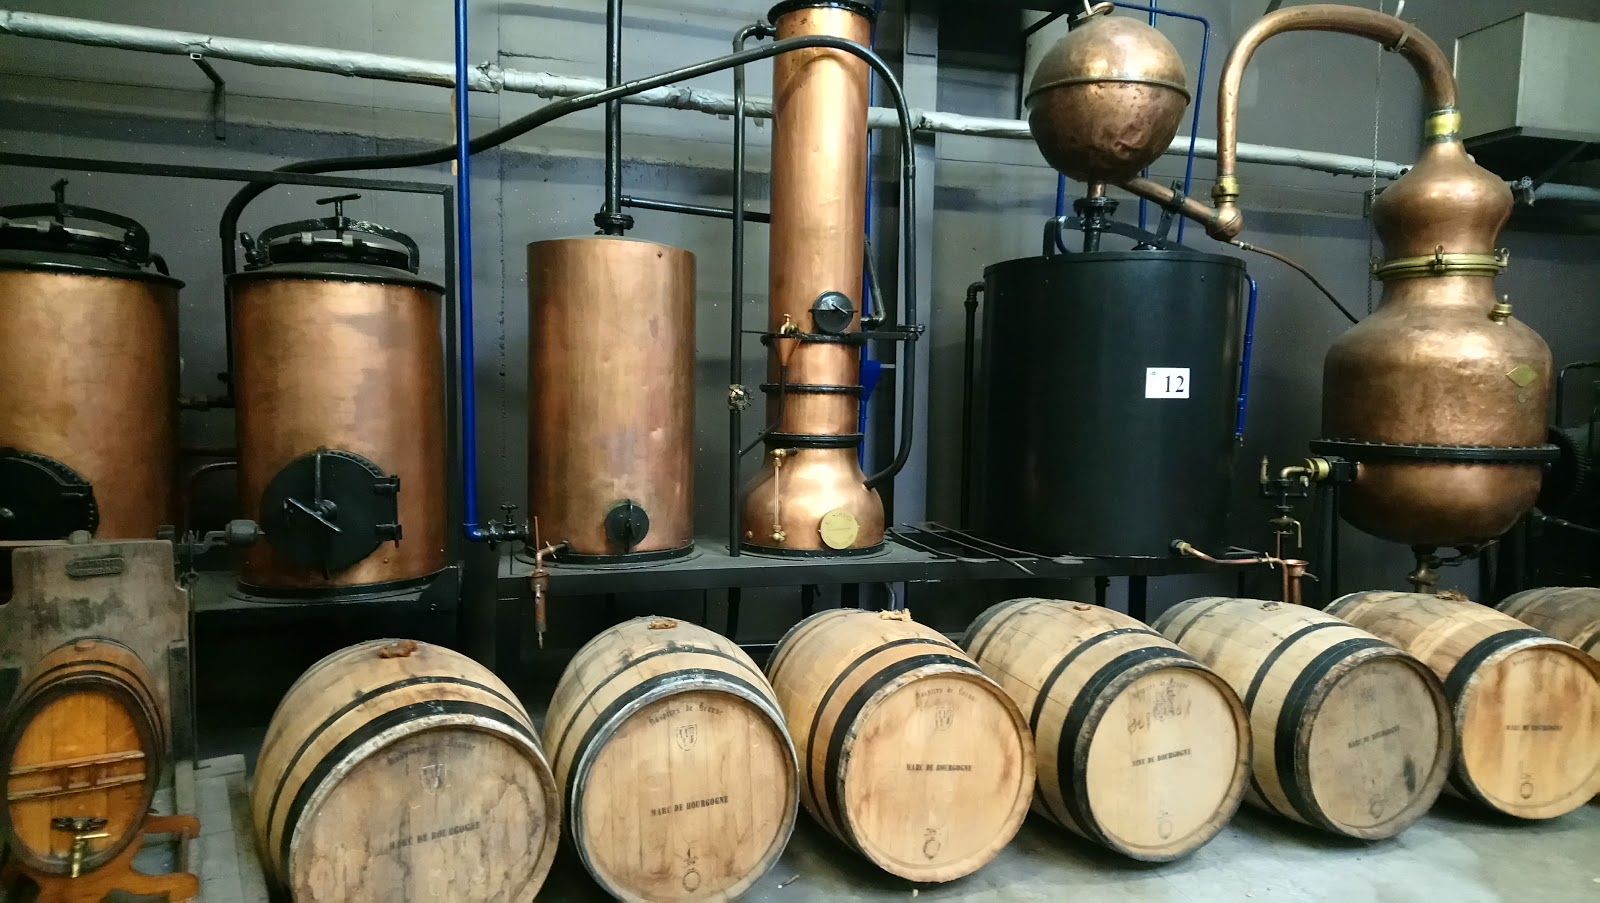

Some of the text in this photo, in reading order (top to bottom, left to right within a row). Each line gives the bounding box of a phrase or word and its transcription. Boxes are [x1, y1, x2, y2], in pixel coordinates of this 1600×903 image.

[1165, 375, 1184, 393] 12
[926, 763, 933, 771] DE
[650, 795, 729, 817] MARC DE BOURGOGNE
